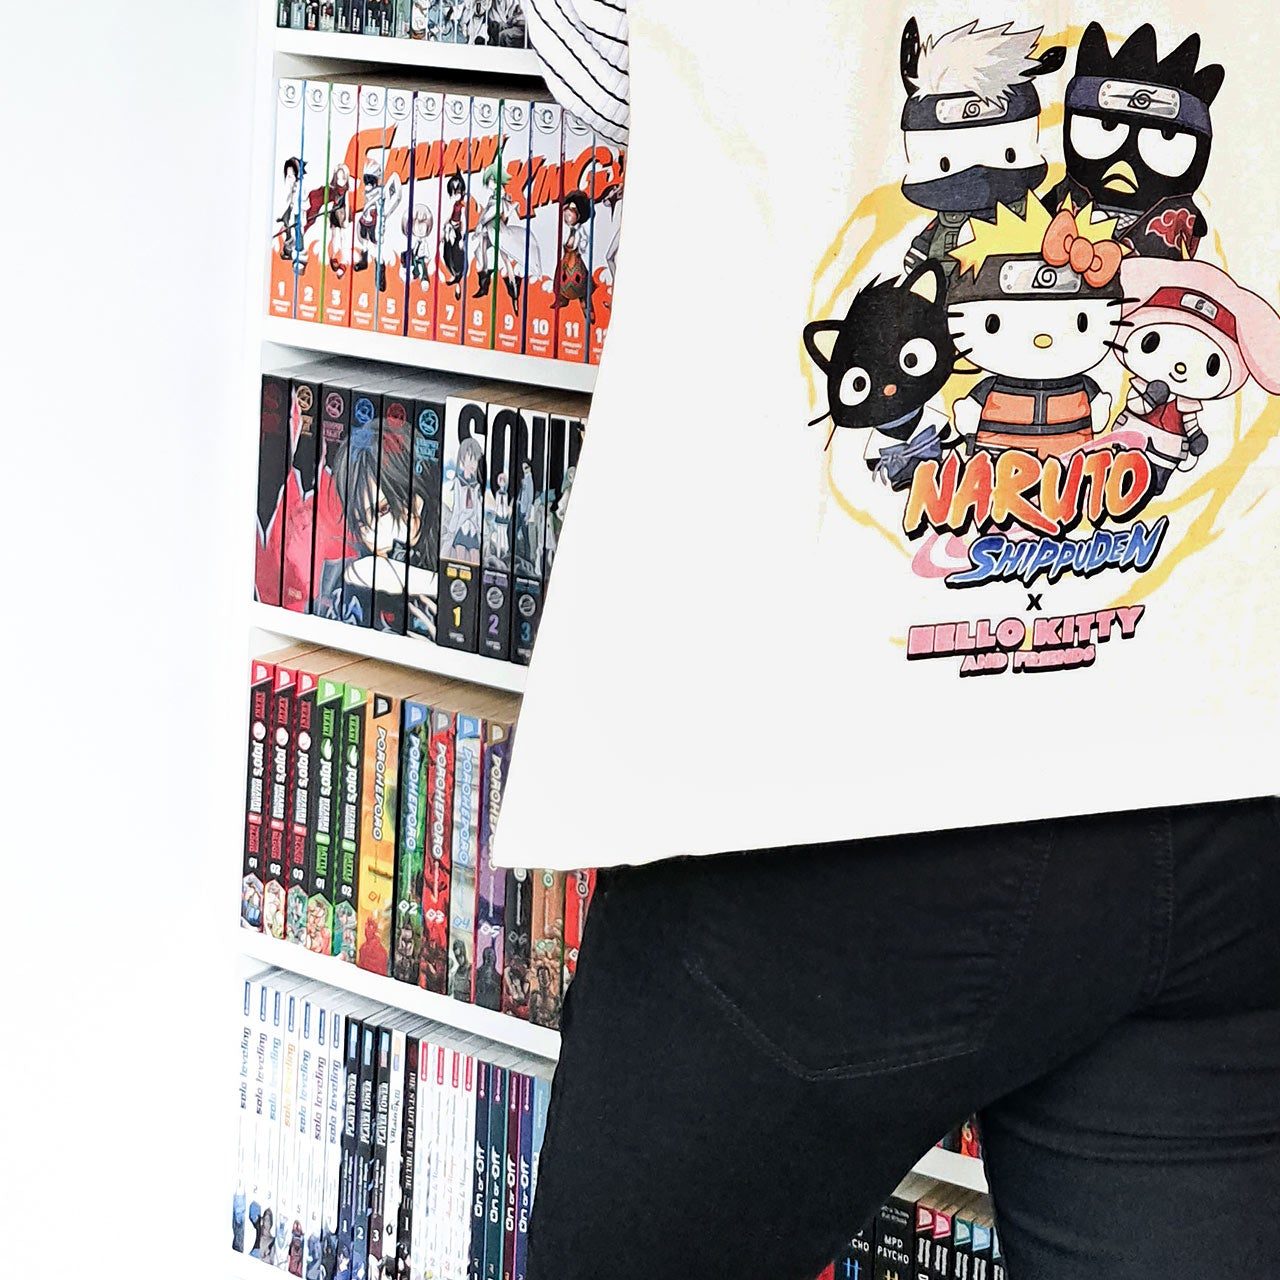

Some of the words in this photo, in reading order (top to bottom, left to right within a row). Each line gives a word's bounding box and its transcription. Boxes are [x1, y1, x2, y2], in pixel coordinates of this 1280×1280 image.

[278, 281, 284, 297] 1
[304, 287, 313, 302] 2
[358, 291, 368, 307] 4
[903, 448, 1155, 540] NARUTO
[946, 517, 1169, 589] SHIPPUDEN
[454, 607, 461, 627] 1
[489, 614, 498, 635] 2
[521, 622, 530, 641] 3
[907, 617, 1026, 660] HELLO
[1032, 605, 1145, 650] KITTY
[960, 649, 1008, 677] AND
[1012, 644, 1096, 673] FRIENDS
[315, 1057, 326, 1108] leveling
[362, 1080, 371, 1110] TOWER
[476, 1140, 484, 1175] Off
[478, 1176, 483, 1191] or
[474, 1193, 483, 1217] On
[357, 1227, 363, 1239] 2
[373, 1230, 379, 1241] 3
[884, 1235, 903, 1248] MPD
[877, 1247, 909, 1264] PSYCHO
